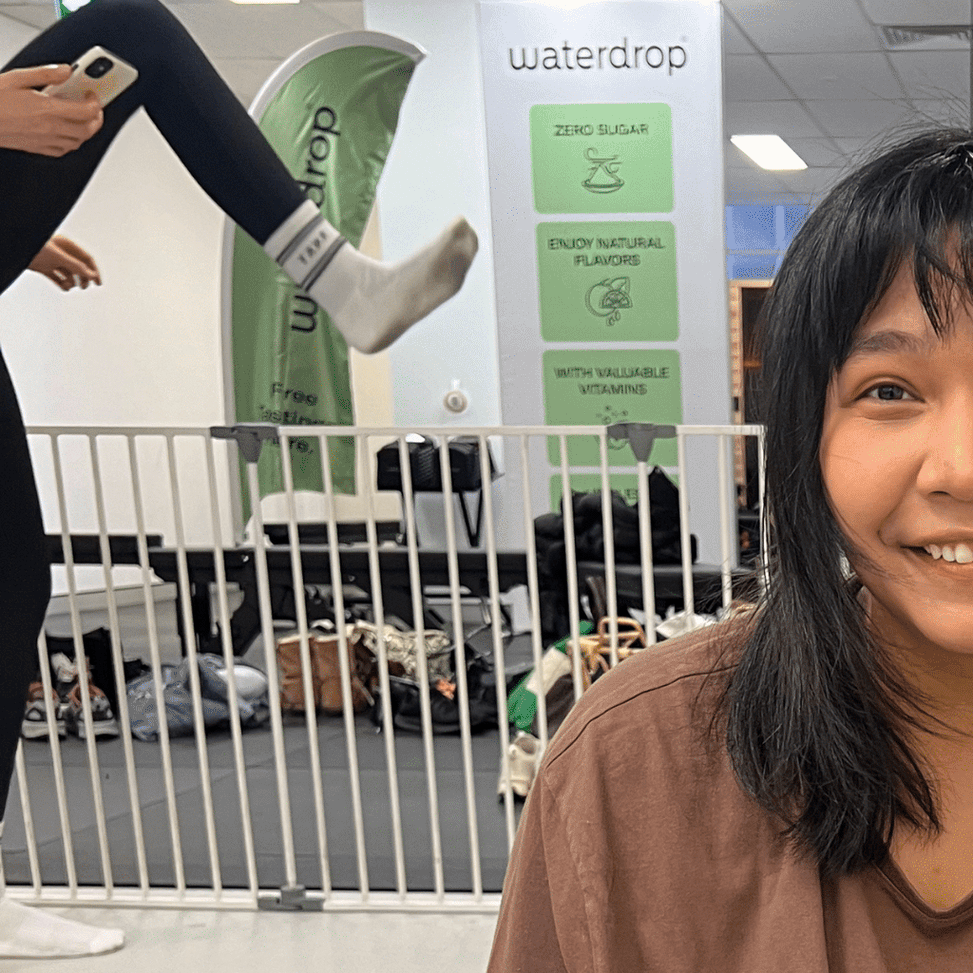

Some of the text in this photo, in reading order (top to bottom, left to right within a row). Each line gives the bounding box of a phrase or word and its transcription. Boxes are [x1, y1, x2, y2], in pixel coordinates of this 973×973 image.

[508, 36, 687, 76] waterdrop
[553, 123, 649, 135] ZERO SUGAR
[291, 105, 341, 333] wdrop
[547, 237, 666, 250] ENJOY NATURAL
[573, 254, 642, 266] FLAVORS
[553, 367, 670, 379] WITH VALUABLE
[577, 384, 648, 396] VITAMINS
[259, 406, 327, 425] astin
